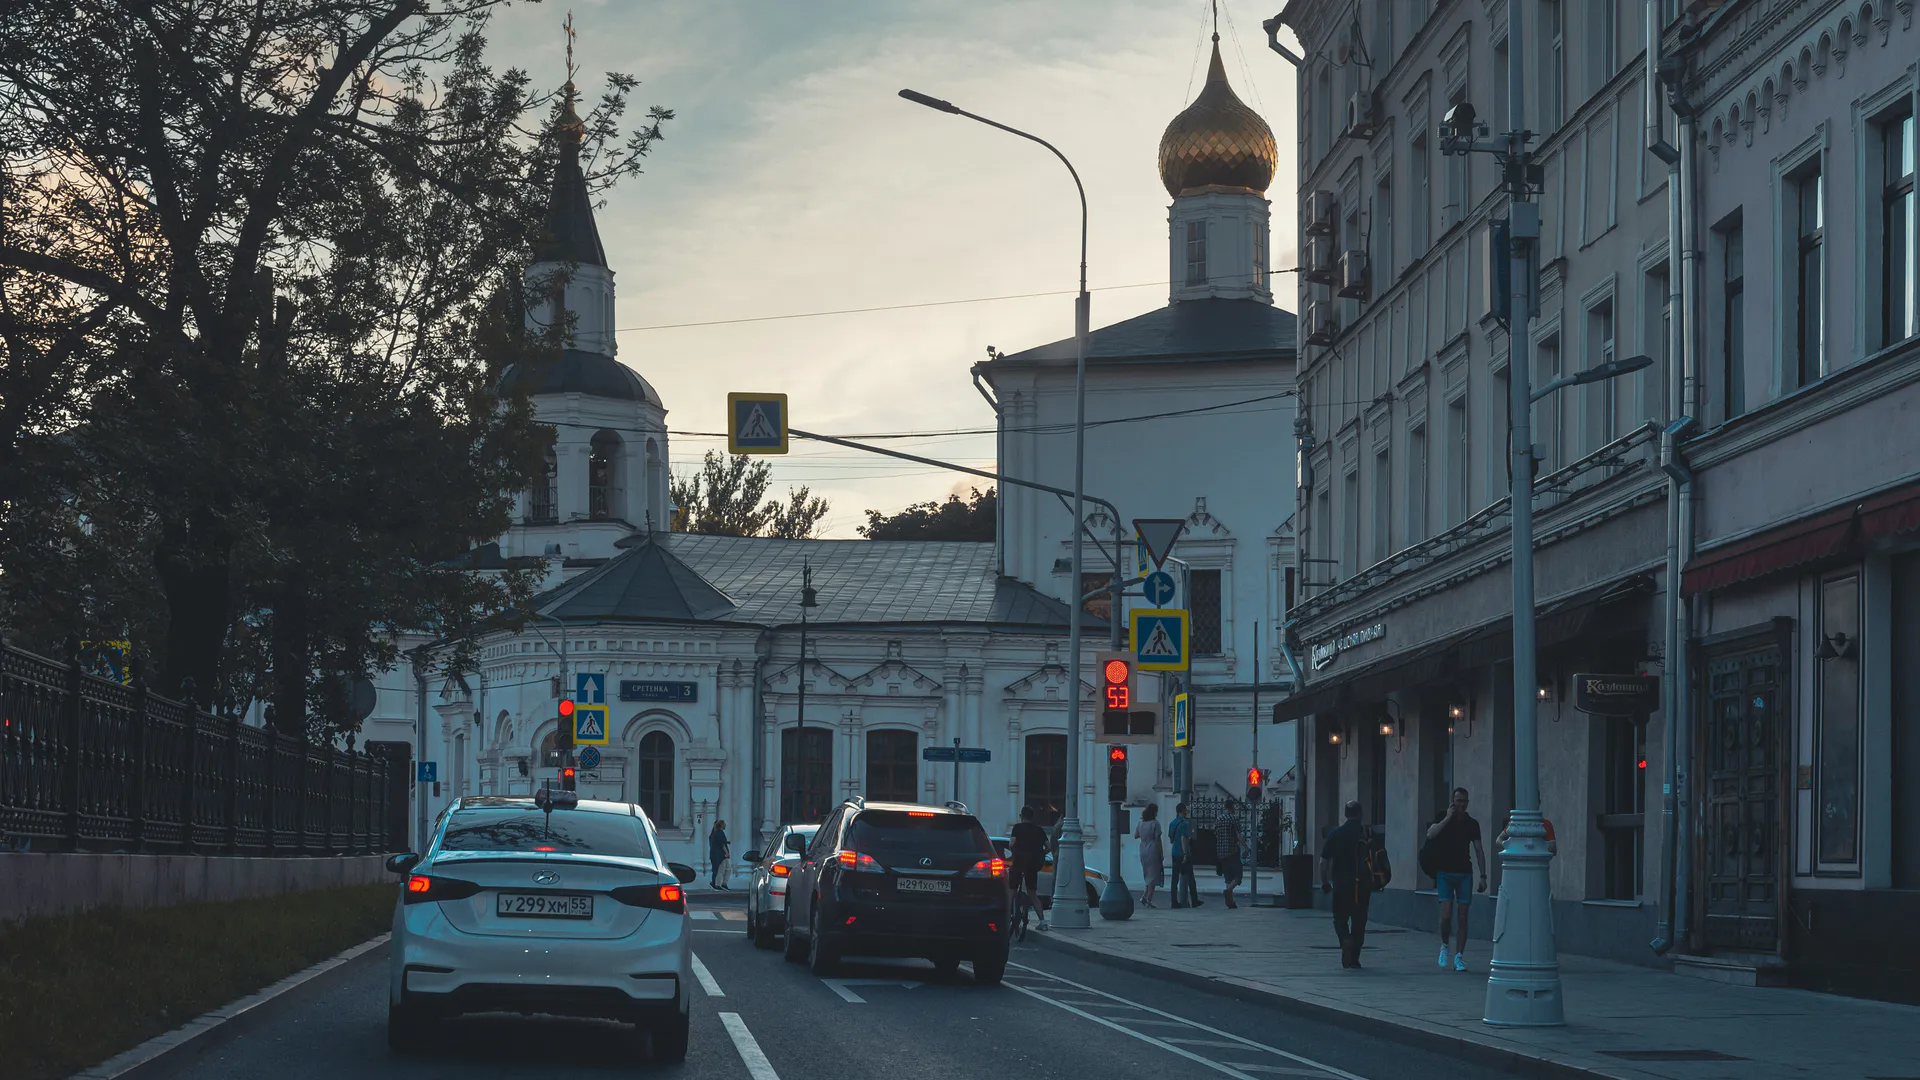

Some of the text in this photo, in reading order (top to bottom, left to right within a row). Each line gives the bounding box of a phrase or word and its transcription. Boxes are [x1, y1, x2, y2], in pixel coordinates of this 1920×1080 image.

[632, 684, 669, 693] СРЕТЕНКА
[683, 685, 691, 697] 3
[1107, 685, 1129, 709] 53
[899, 879, 949, 891] Н291ХО 199
[571, 897, 587, 910] 55
